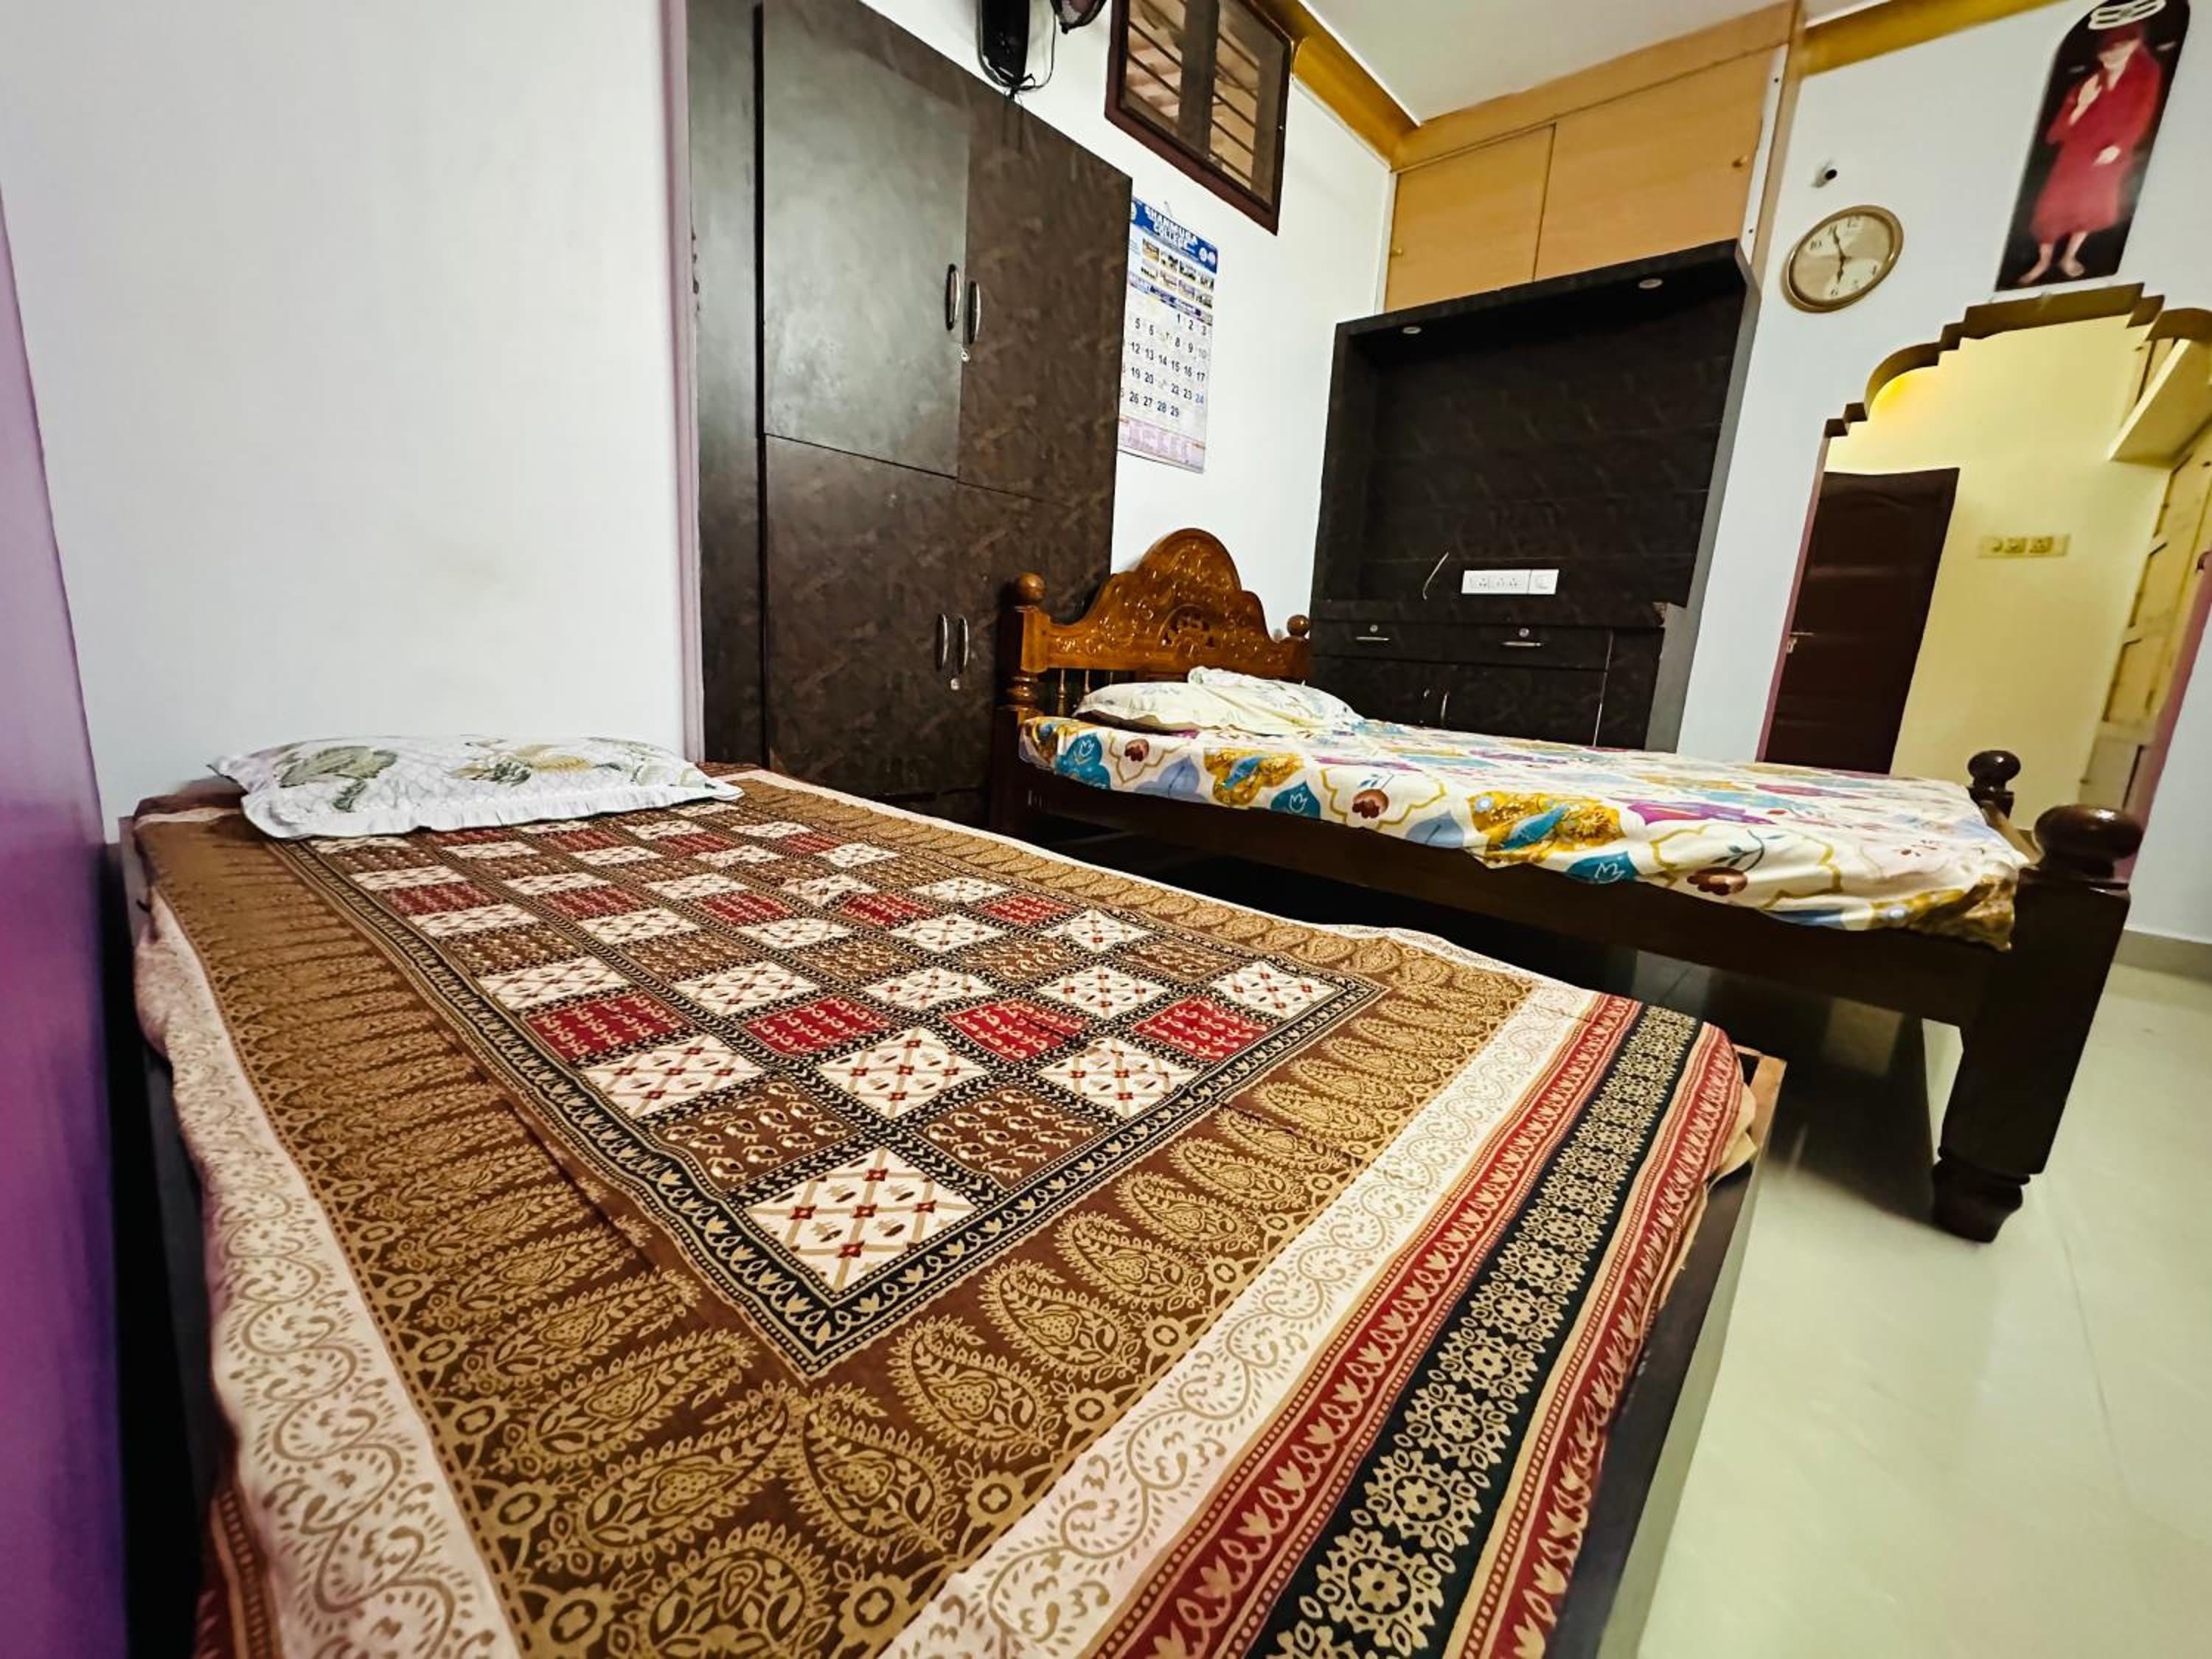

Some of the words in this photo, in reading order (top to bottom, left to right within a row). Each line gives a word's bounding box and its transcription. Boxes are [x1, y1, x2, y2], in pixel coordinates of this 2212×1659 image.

[1135, 318, 1141, 329] 5
[1130, 341, 1141, 354] 12
[1145, 348, 1154, 360] 13
[1158, 355, 1167, 366] 14
[1171, 361, 1180, 372] 15
[1197, 372, 1206, 382] 17
[1131, 366, 1141, 379] 19
[1183, 389, 1192, 400] 23
[1129, 391, 1138, 404] 26
[1144, 396, 1152, 408] 27
[1157, 400, 1167, 413] 28
